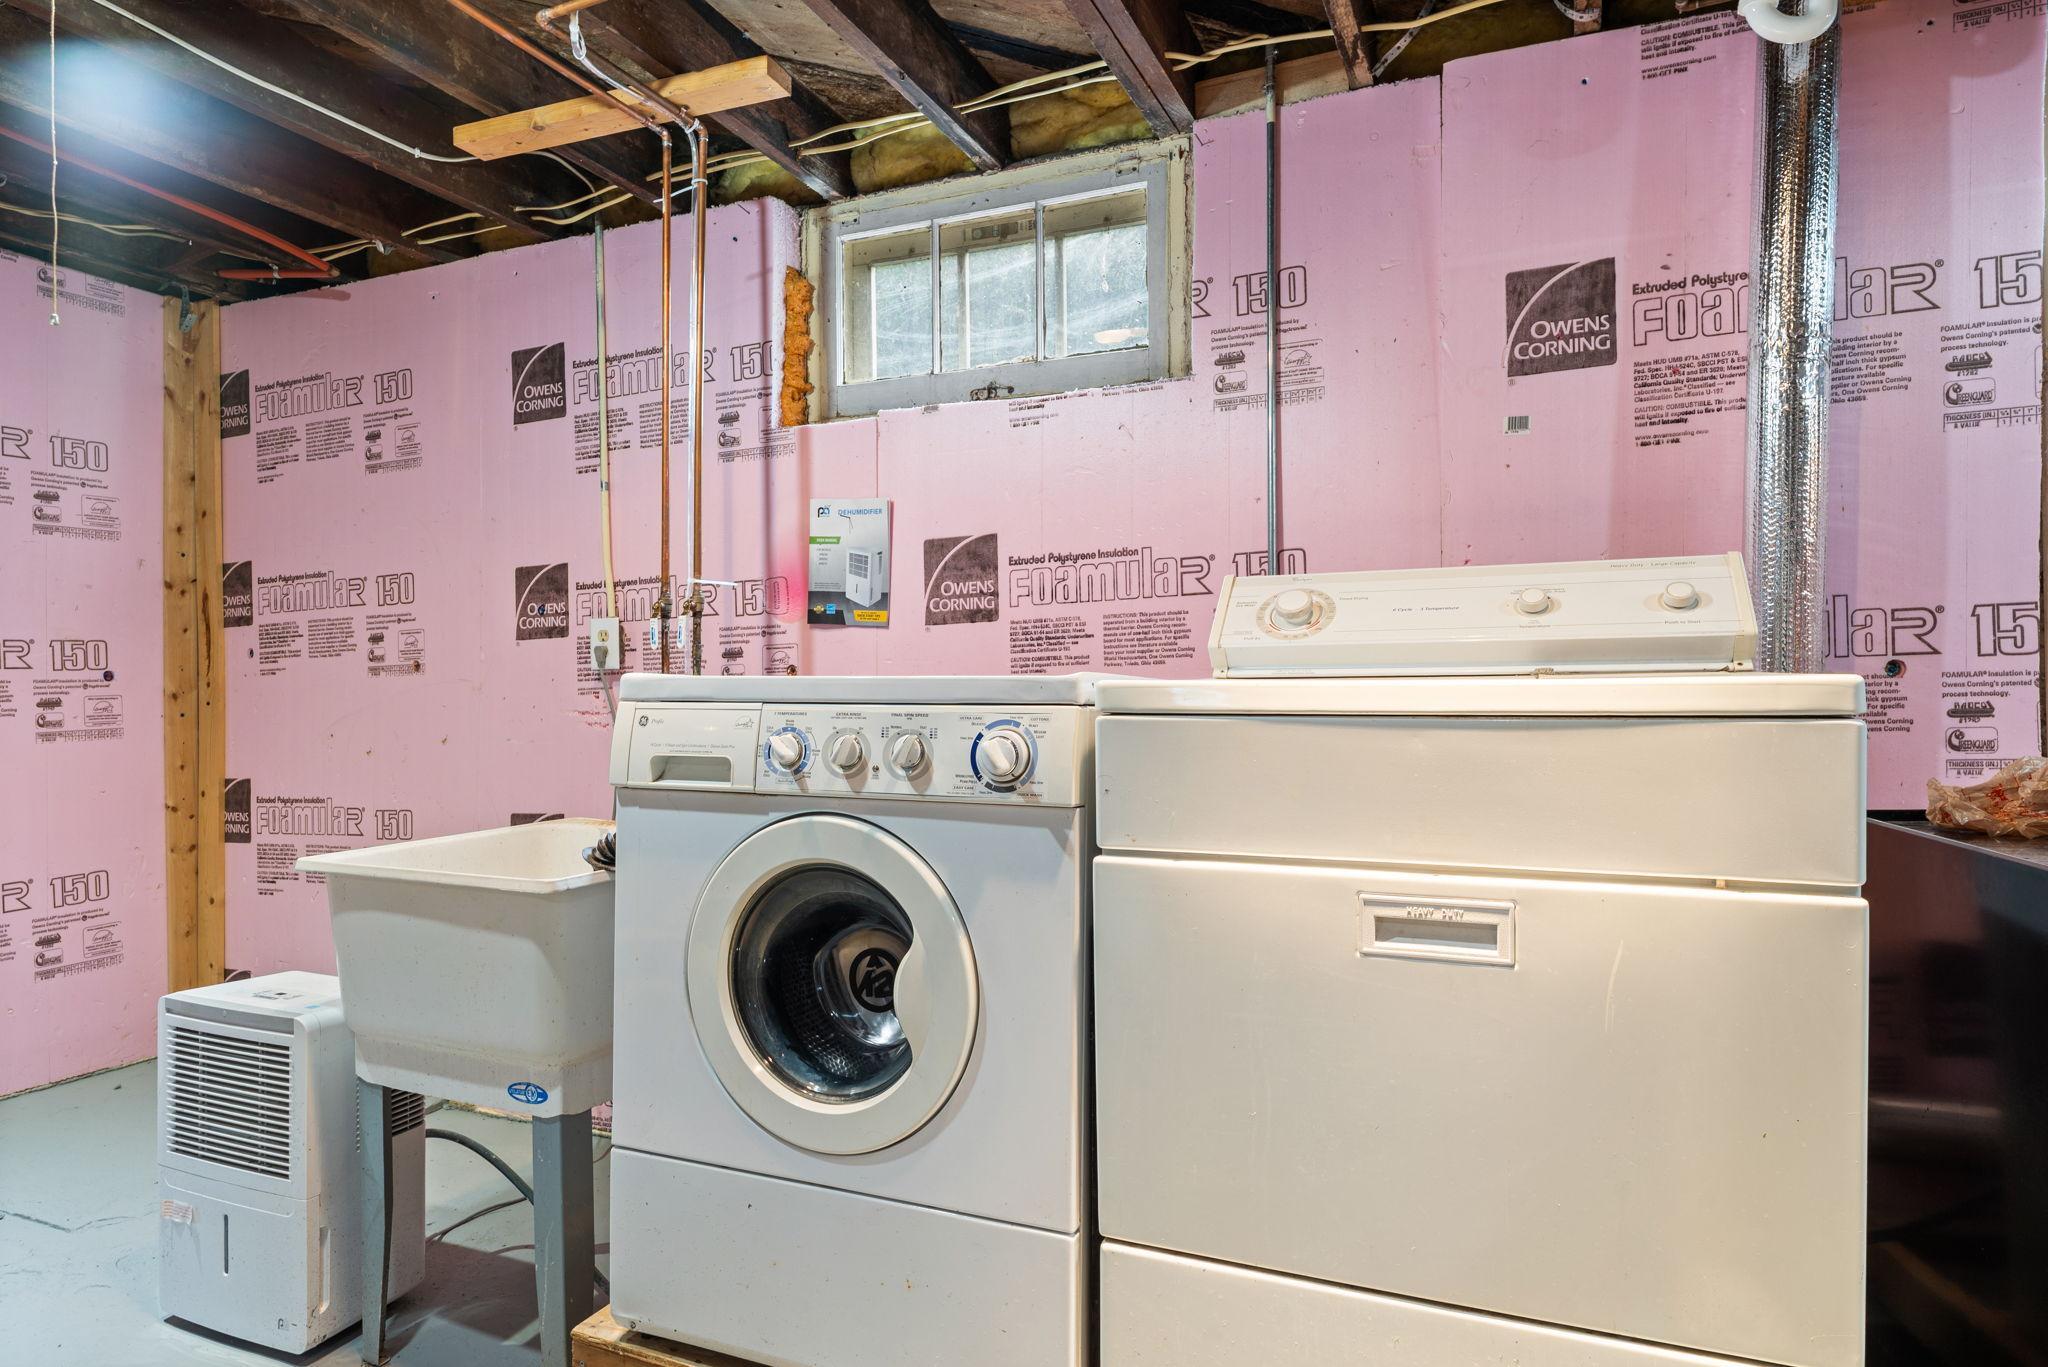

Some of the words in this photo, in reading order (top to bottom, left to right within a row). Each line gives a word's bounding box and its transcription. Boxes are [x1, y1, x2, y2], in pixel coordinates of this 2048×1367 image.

[1641, 22, 1680, 35] Classification
[1681, 15, 1713, 26] Certificate
[1641, 35, 1671, 46] CAUTION:
[1723, 21, 1735, 29] This
[1654, 43, 1670, 52] ignite
[1678, 36, 1703, 46] exposed
[1713, 31, 1723, 39] fire
[1632, 277, 1687, 296] Extruded
[1530, 315, 1610, 339] OWENS
[1987, 318, 2022, 327] Insulation
[1842, 336, 1868, 344] product
[1870, 332, 1893, 340] should
[1966, 331, 1997, 339] Corning's
[1999, 327, 2030, 336] patented
[1514, 334, 1611, 360] CORNING
[1940, 344, 1967, 353] process
[1969, 340, 2009, 349] technology.
[573, 358, 599, 369] Extruded
[1880, 354, 1906, 362] gypsum
[1879, 361, 1904, 370] specific
[1857, 371, 1885, 380] available
[1885, 376, 1912, 384] Corning
[255, 381, 275, 392] Extruded
[276, 377, 301, 390] Polystyrene
[303, 374, 325, 384] Insulation
[374, 369, 413, 404] 150
[1688, 382, 1716, 390] Classified
[524, 382, 563, 399] OWENS
[1634, 394, 1673, 403] Classification
[1674, 391, 1705, 399] Certificate
[516, 397, 564, 413] CORNING
[1666, 400, 1713, 409] COMBUSTIBLE.
[1671, 409, 1695, 417] exposed
[1946, 412, 1981, 421] THICKNESS
[49, 435, 109, 472] 150
[1008, 554, 1045, 566] Extruded
[1048, 551, 1097, 565] Polystyrene
[1098, 547, 1139, 559] Insulation
[258, 576, 278, 585] Extruded
[279, 573, 304, 584] Polystyrene
[305, 571, 327, 580] Insulation
[376, 573, 415, 606] 150
[576, 581, 603, 590] Extruded
[941, 580, 995, 596] OWENS
[732, 576, 790, 617] 150
[929, 594, 995, 614] CORNING
[519, 616, 566, 629] CORNING
[49, 639, 109, 671] 150
[1988, 669, 2024, 677] Insulation
[257, 796, 277, 804] Extruded
[278, 796, 303, 806] Polystyrene
[304, 796, 325, 804] Insulation
[224, 824, 249, 834] RNING
[375, 809, 413, 840] 150
[49, 870, 110, 909] 150
[1406, 906, 1434, 918] HEAVY
[1441, 908, 1464, 920] DUTY
